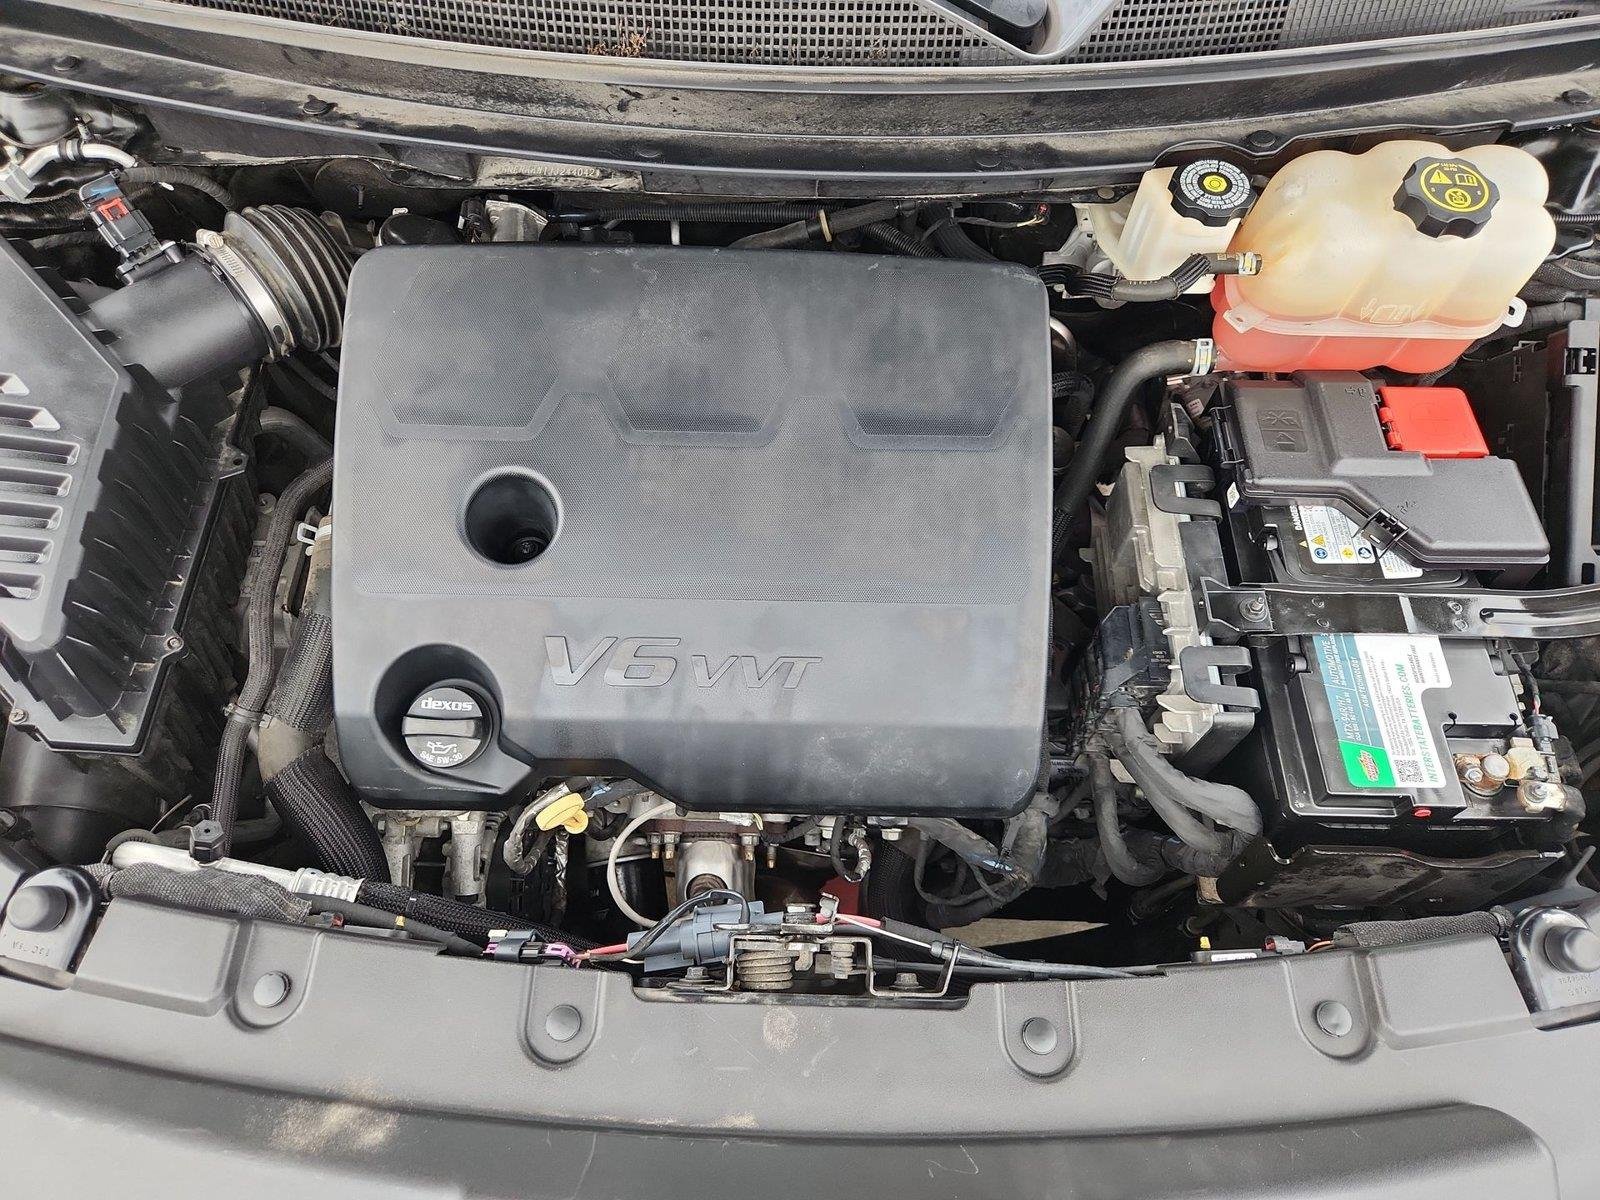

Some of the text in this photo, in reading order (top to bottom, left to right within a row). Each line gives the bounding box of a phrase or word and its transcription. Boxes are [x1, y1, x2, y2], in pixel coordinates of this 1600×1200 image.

[545, 635, 823, 690] V6 VVT
[1323, 641, 1340, 685] AUTOMOTIVE
[421, 697, 474, 711] dexos
[1395, 663, 1438, 782] INTERSTATEBATTERIES.COM
[420, 750, 435, 763] SAE
